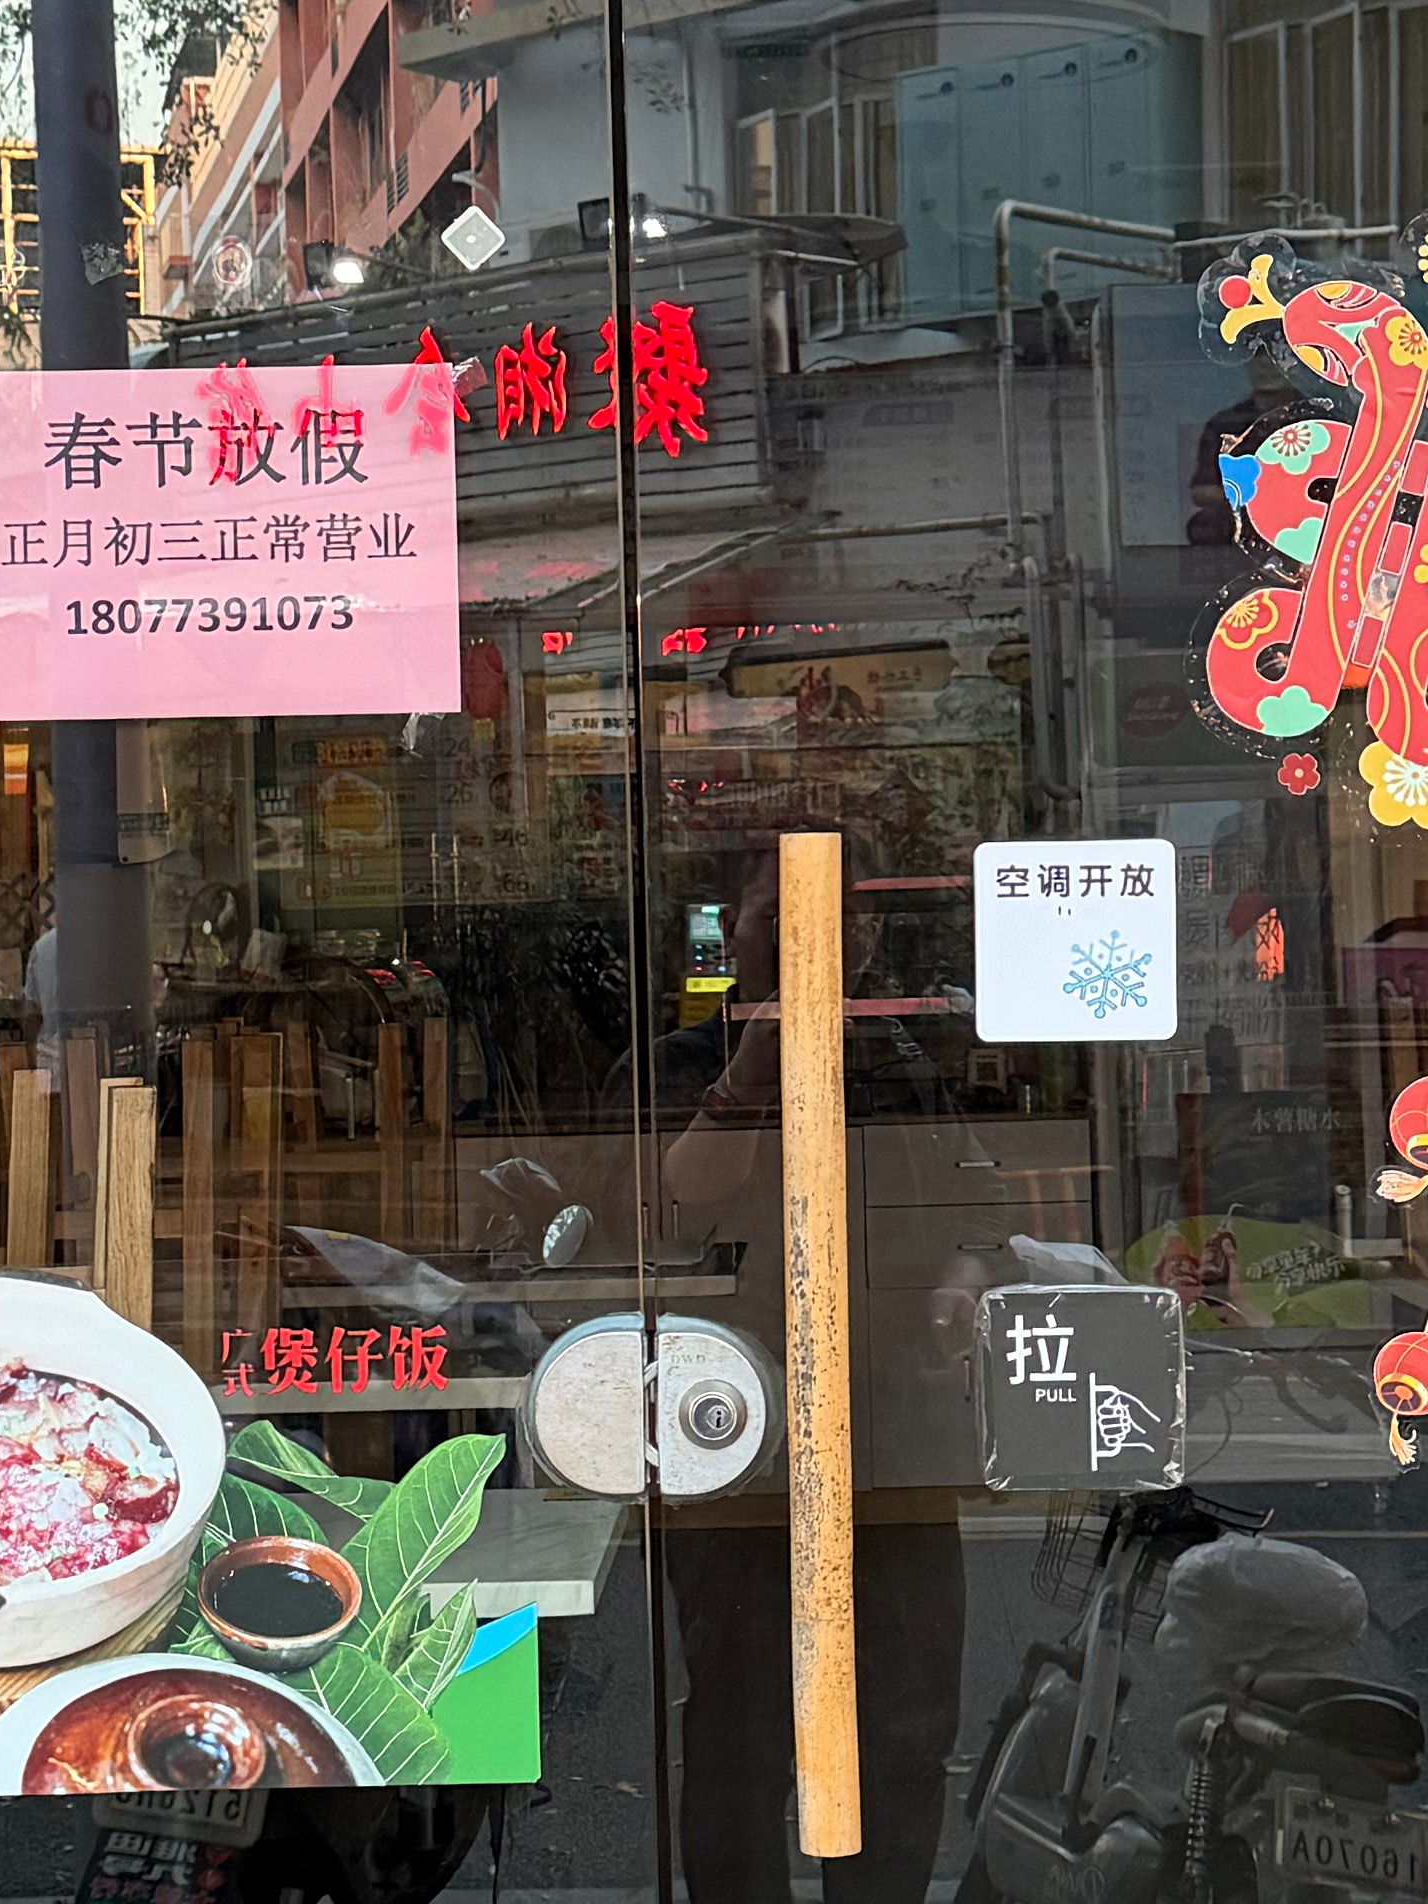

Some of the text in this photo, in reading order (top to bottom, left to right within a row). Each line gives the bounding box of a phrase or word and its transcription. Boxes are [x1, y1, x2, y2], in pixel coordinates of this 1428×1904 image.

[44, 409, 370, 490] 春节放假
[1, 511, 419, 569] 正月初三正常营业
[65, 594, 356, 636] 18077391073
[994, 861, 1157, 900] 空调开放
[220, 1323, 450, 1399] 广式 煲仔饭
[1006, 1313, 1077, 1387] 拉
[1034, 1387, 1078, 1405] PULL
